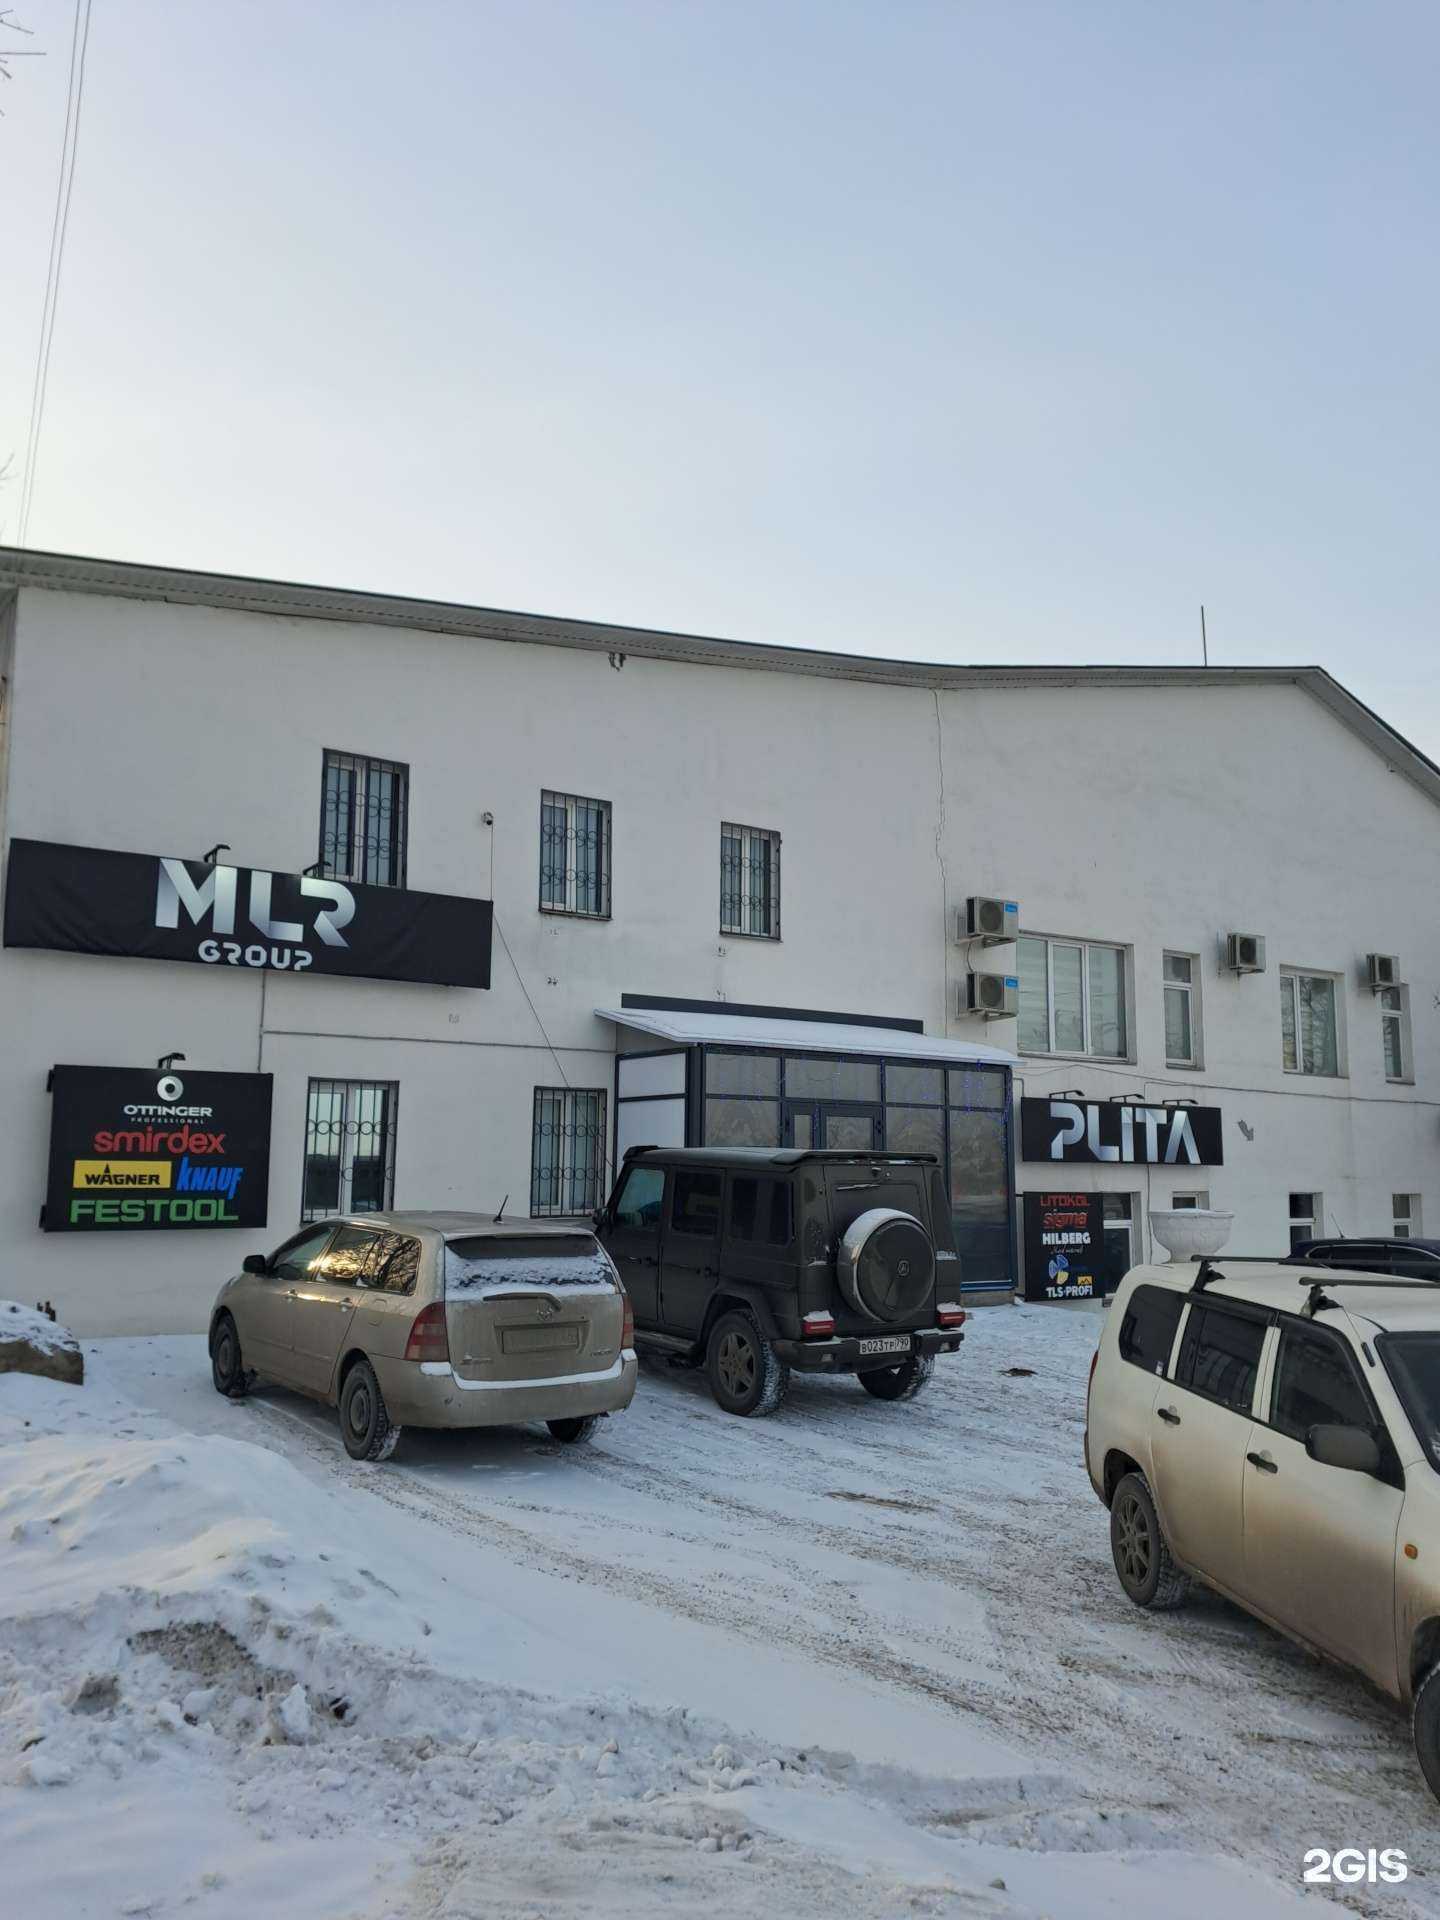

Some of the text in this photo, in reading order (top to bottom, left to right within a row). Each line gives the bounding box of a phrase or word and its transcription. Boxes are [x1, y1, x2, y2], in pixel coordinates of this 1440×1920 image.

[155, 857, 356, 948] MLR
[198, 939, 313, 971] GROUP
[123, 1104, 213, 1118] OTTINGER
[130, 1117, 205, 1125] PROFESSIONAL
[93, 1124, 226, 1154] smirdex
[1050, 1101, 1202, 1165] PLITA
[85, 1170, 160, 1186] WAGNER
[70, 1199, 239, 1224] FESTOOL
[1042, 1231, 1091, 1246] HILBERG
